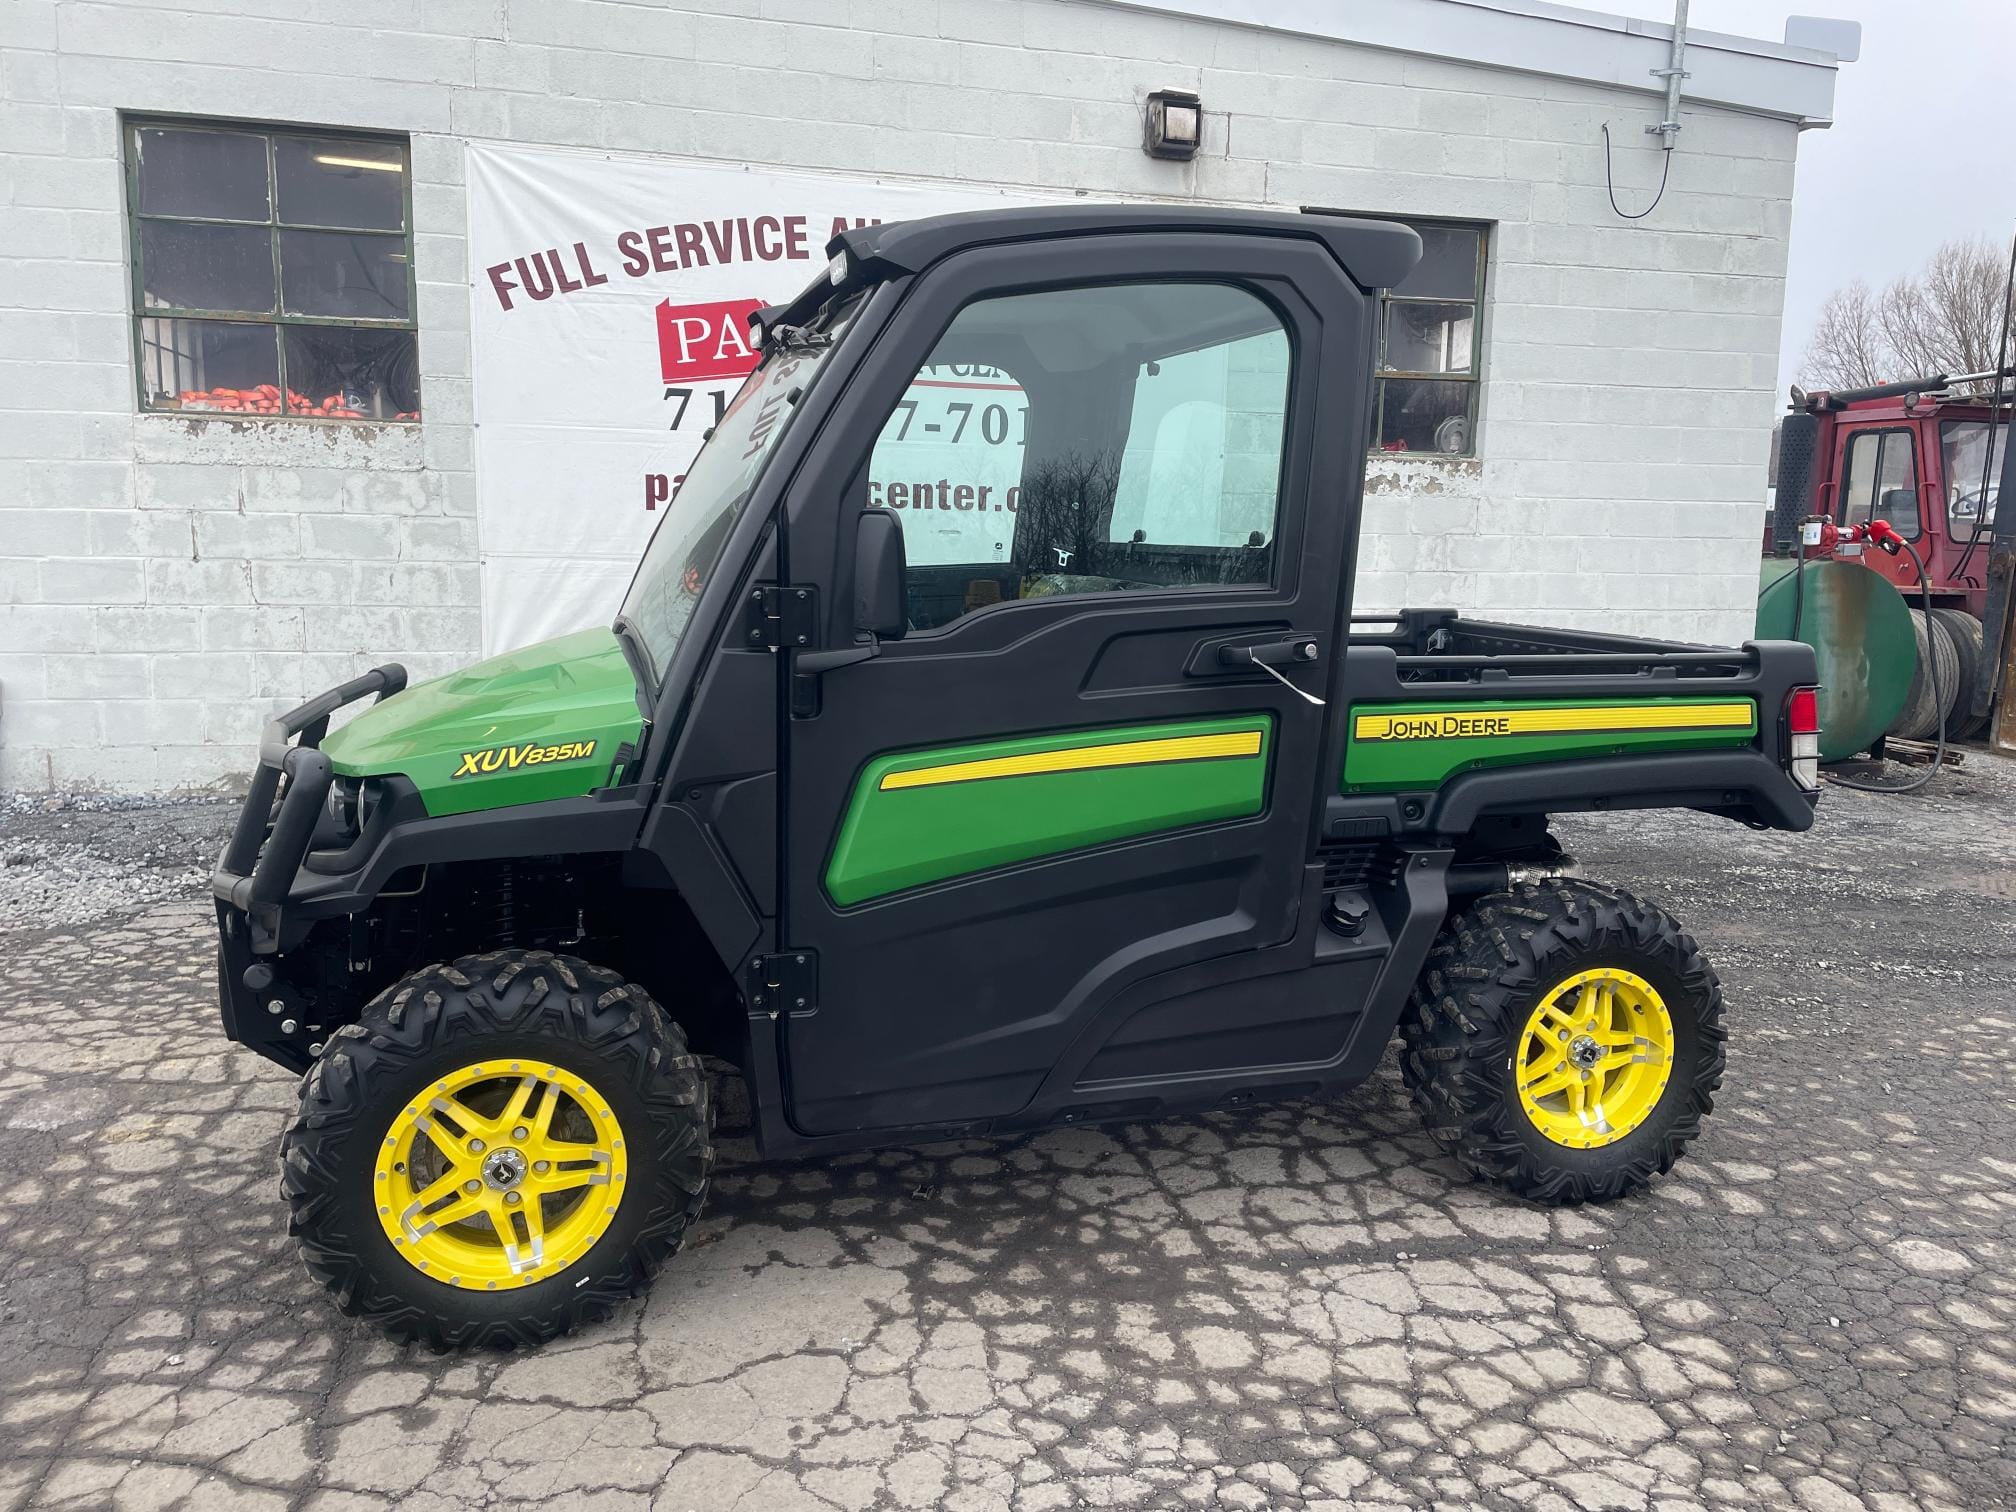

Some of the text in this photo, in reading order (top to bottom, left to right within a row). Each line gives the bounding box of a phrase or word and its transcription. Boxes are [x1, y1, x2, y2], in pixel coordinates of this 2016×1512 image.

[486, 216, 809, 311] FULL SERVICE
[671, 313, 753, 365] PA
[1381, 717, 1510, 738] JOHN DEERE
[453, 740, 596, 778] XUV835M
